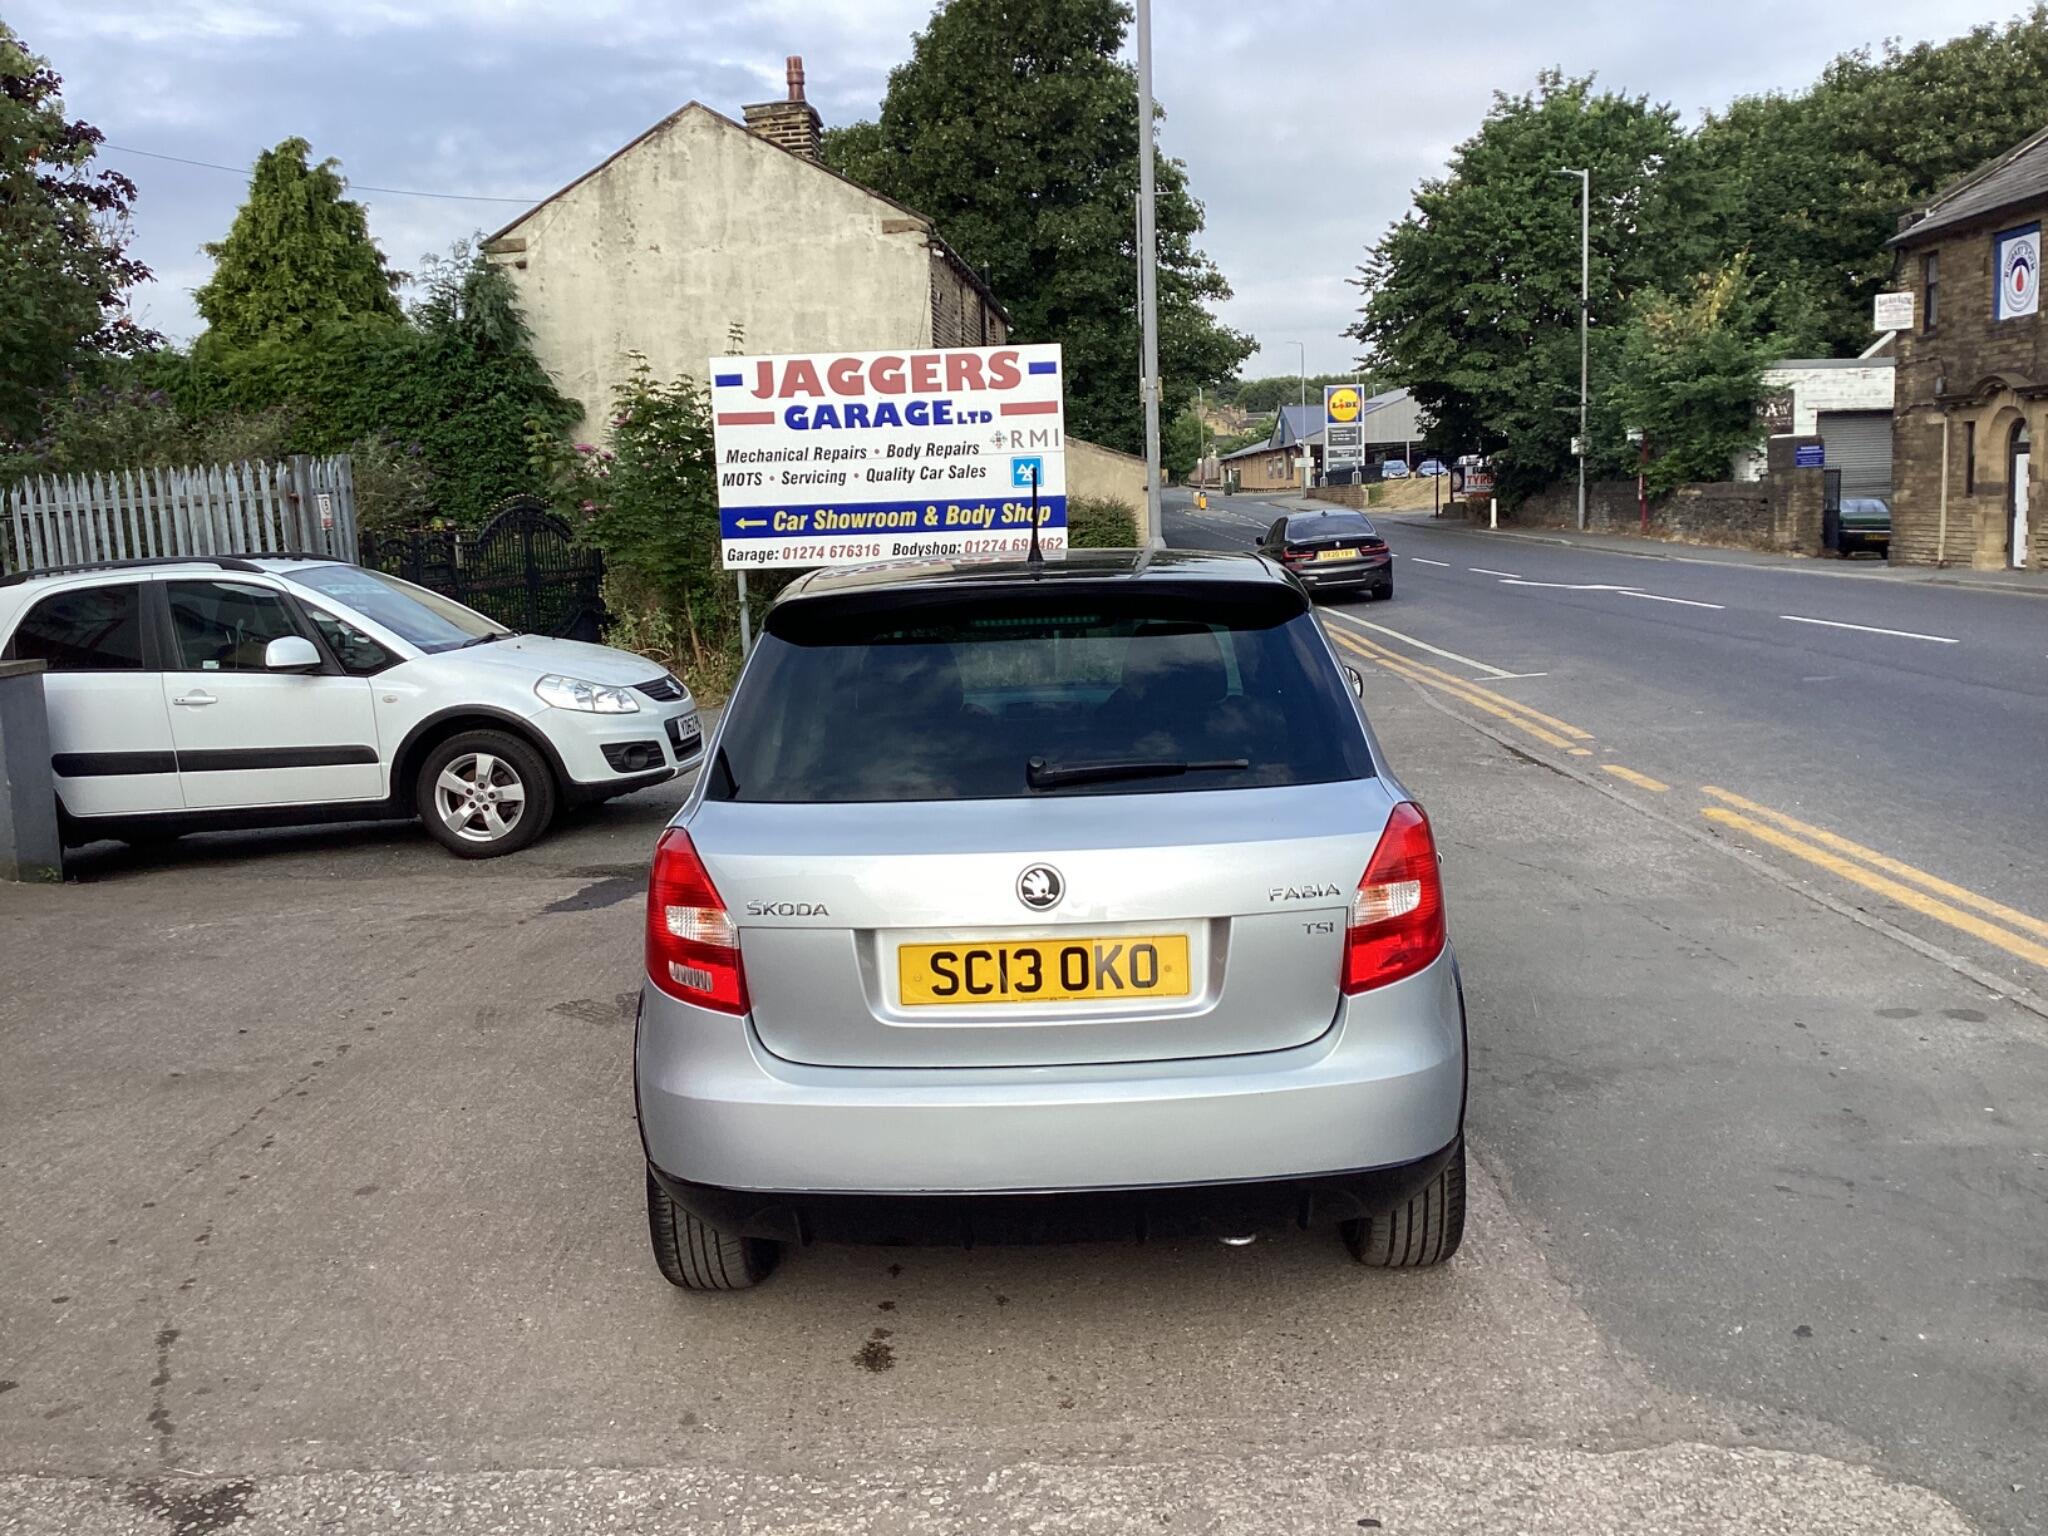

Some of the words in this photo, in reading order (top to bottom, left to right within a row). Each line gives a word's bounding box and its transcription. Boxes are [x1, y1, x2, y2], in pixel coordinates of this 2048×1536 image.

[750, 351, 1022, 399] JAGGERS
[784, 399, 953, 431] GARAGE
[957, 410, 993, 425] LTD
[1010, 428, 1060, 449] RMI
[726, 447, 809, 464] Mechanical
[813, 445, 867, 463] Repairs
[886, 442, 921, 460] Body
[926, 441, 980, 459] Repairs
[722, 472, 763, 487] MOTS
[781, 469, 847, 487] Servicing
[866, 466, 915, 484] Quality
[920, 464, 944, 480] Car
[948, 464, 987, 480] Sales
[773, 510, 808, 531] Car
[813, 508, 917, 530] Showroom
[924, 505, 938, 526] &
[945, 504, 995, 528] Body
[1001, 502, 1051, 527] Shop
[727, 547, 779, 563] Garage:
[782, 546, 825, 560] 01274
[829, 543, 881, 558] 676316
[892, 541, 961, 557] Bodyshop:
[964, 539, 1007, 554] 01274
[1012, 537, 1064, 551] 69462
[1269, 883, 1341, 901] FABIA
[930, 947, 1043, 996] SC13
[1060, 943, 1159, 992] OKO
